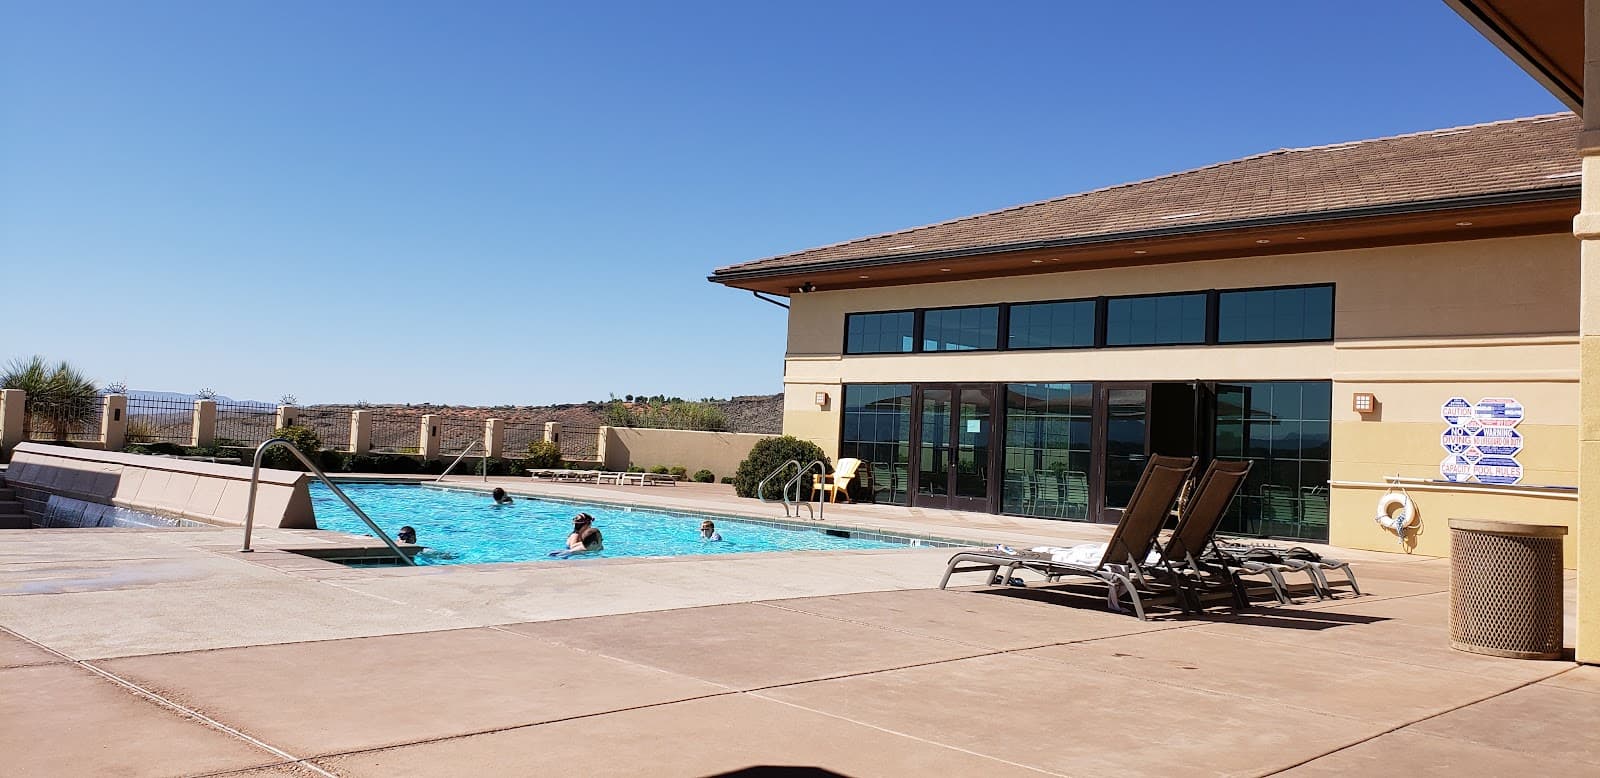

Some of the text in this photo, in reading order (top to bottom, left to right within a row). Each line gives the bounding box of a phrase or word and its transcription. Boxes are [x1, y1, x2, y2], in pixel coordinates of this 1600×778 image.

[1442, 408, 1472, 416] CAUTION
[1451, 427, 1464, 436] NO
[1484, 428, 1512, 437] WARNING
[1442, 436, 1472, 445] DIVING
[1441, 464, 1471, 473] CAPACITY
[1473, 467, 1521, 476] POOL RULES
